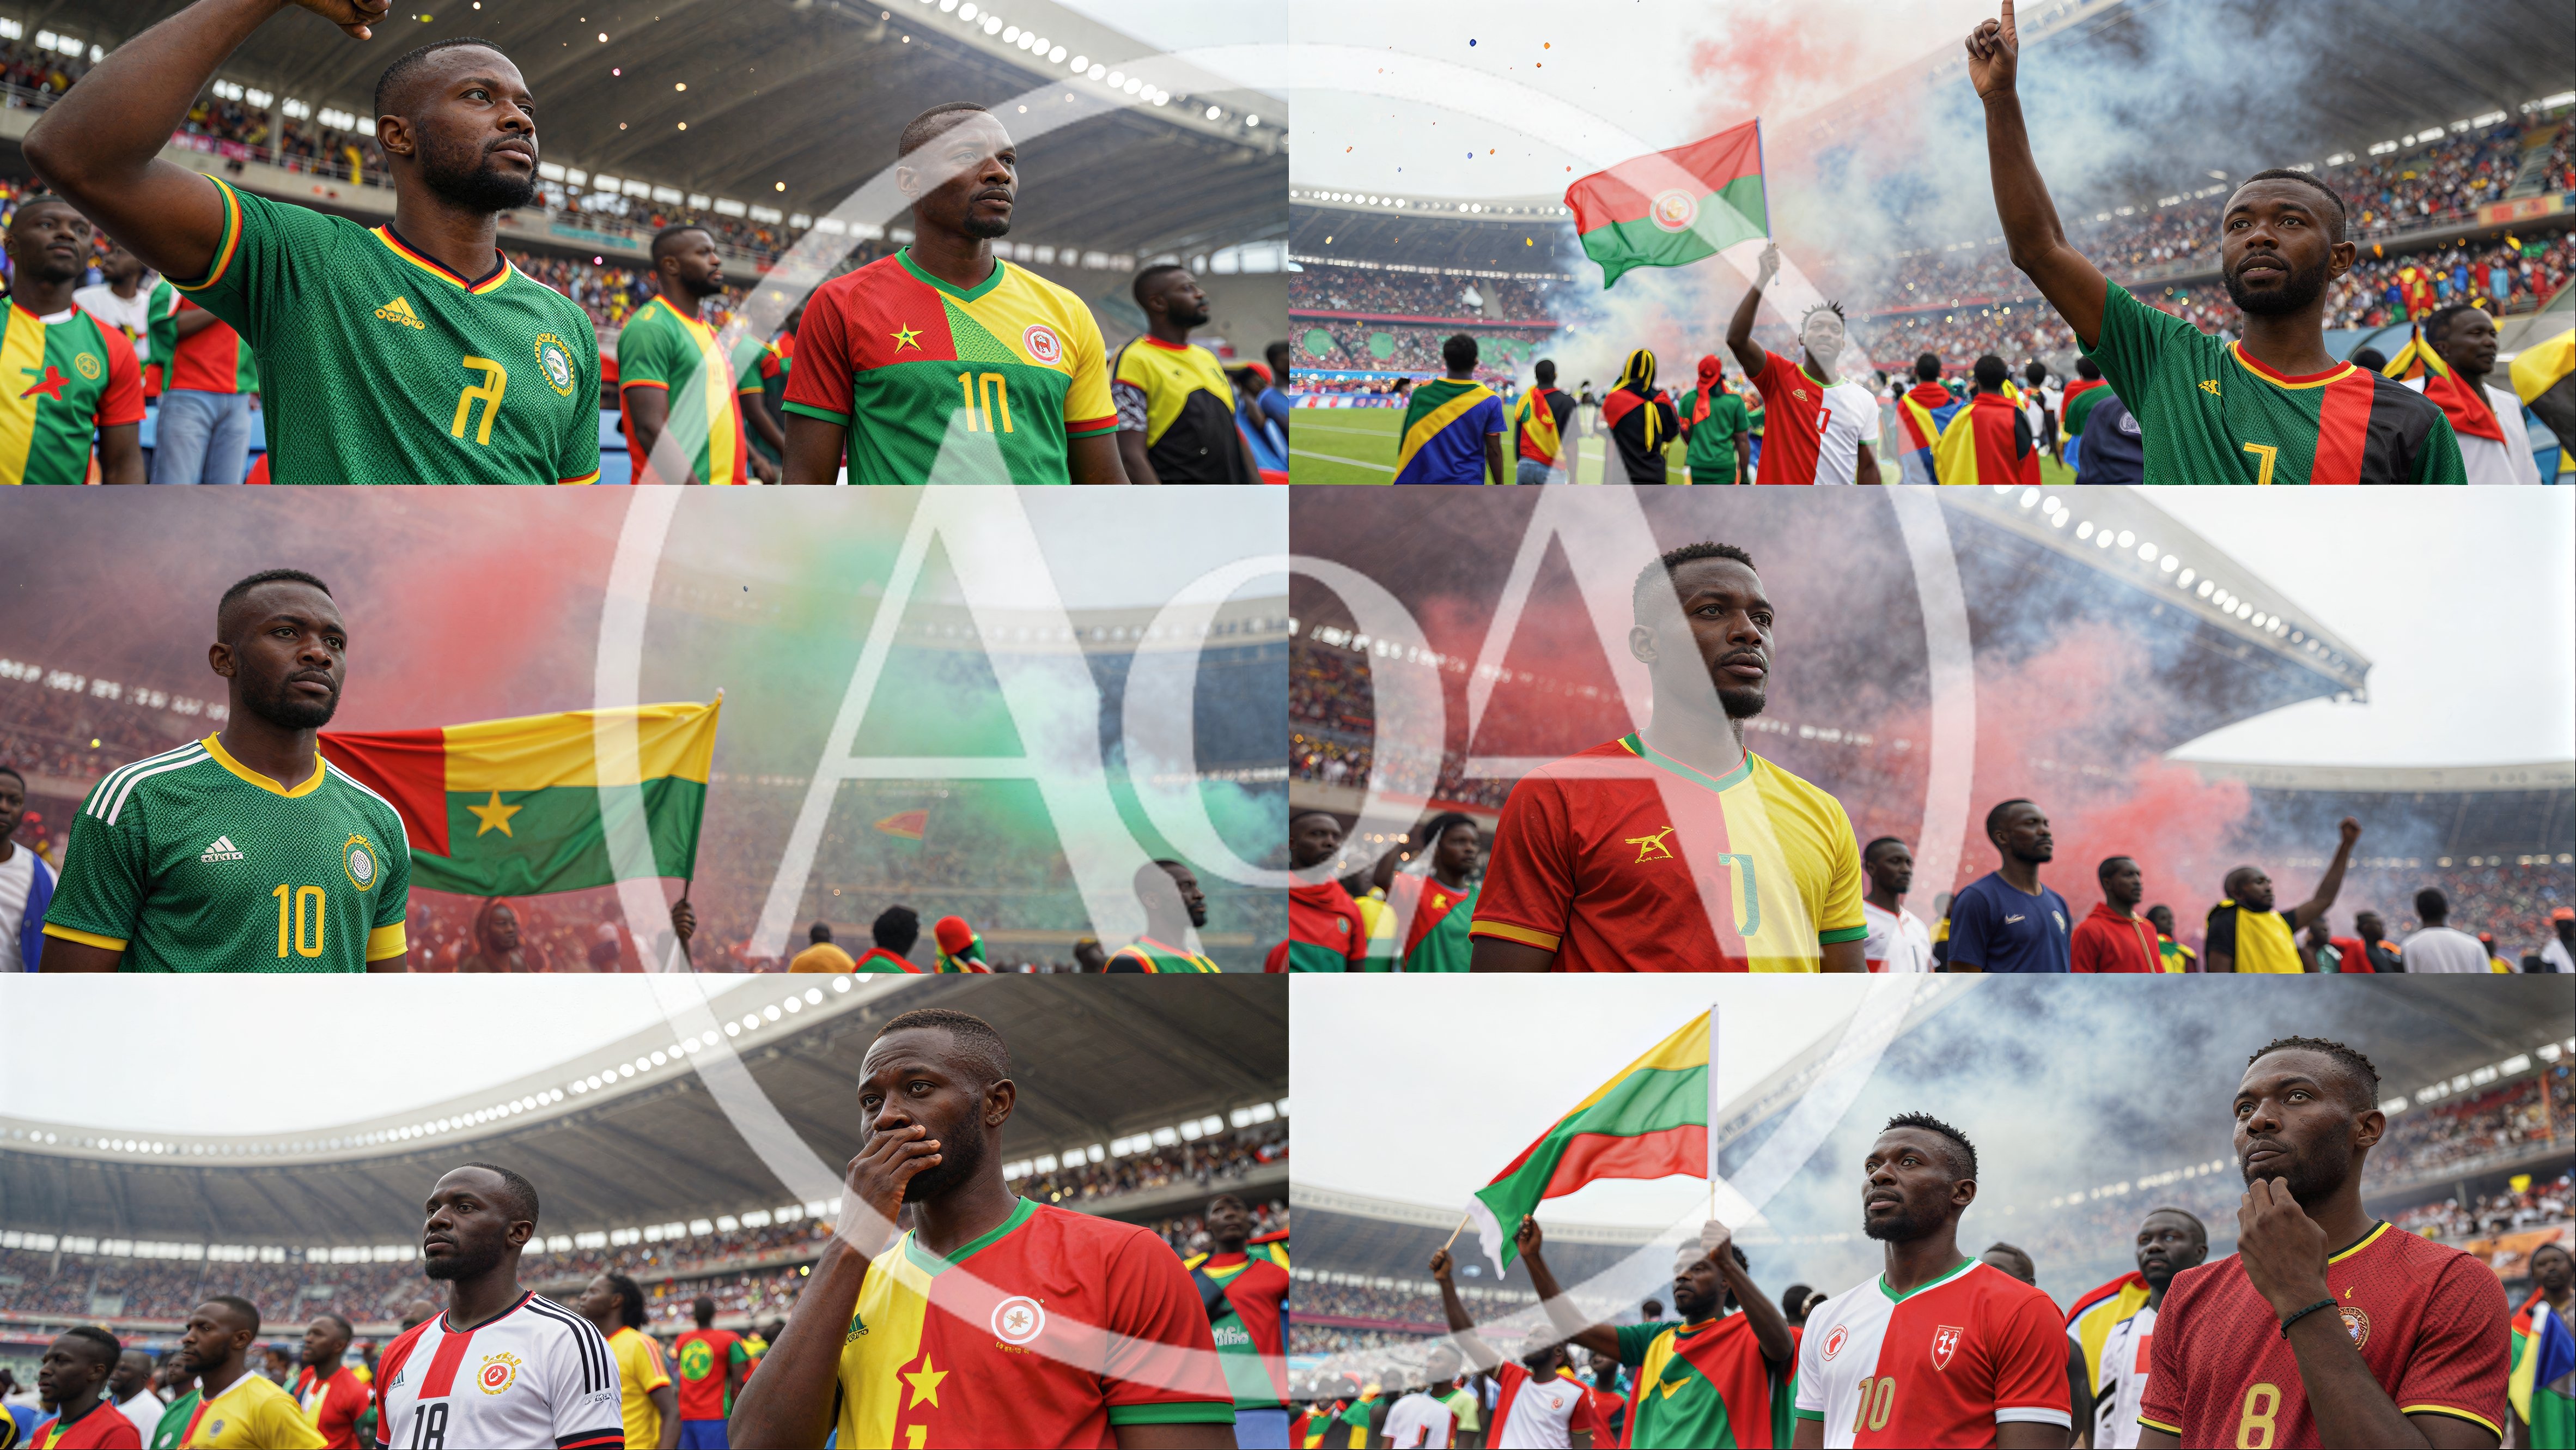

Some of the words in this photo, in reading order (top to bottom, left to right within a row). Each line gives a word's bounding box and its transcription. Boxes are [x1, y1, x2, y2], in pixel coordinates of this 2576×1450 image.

[272, 883, 326, 958] 10
[1852, 1376, 1896, 1434] 10
[2236, 1382, 2282, 1449] 8
